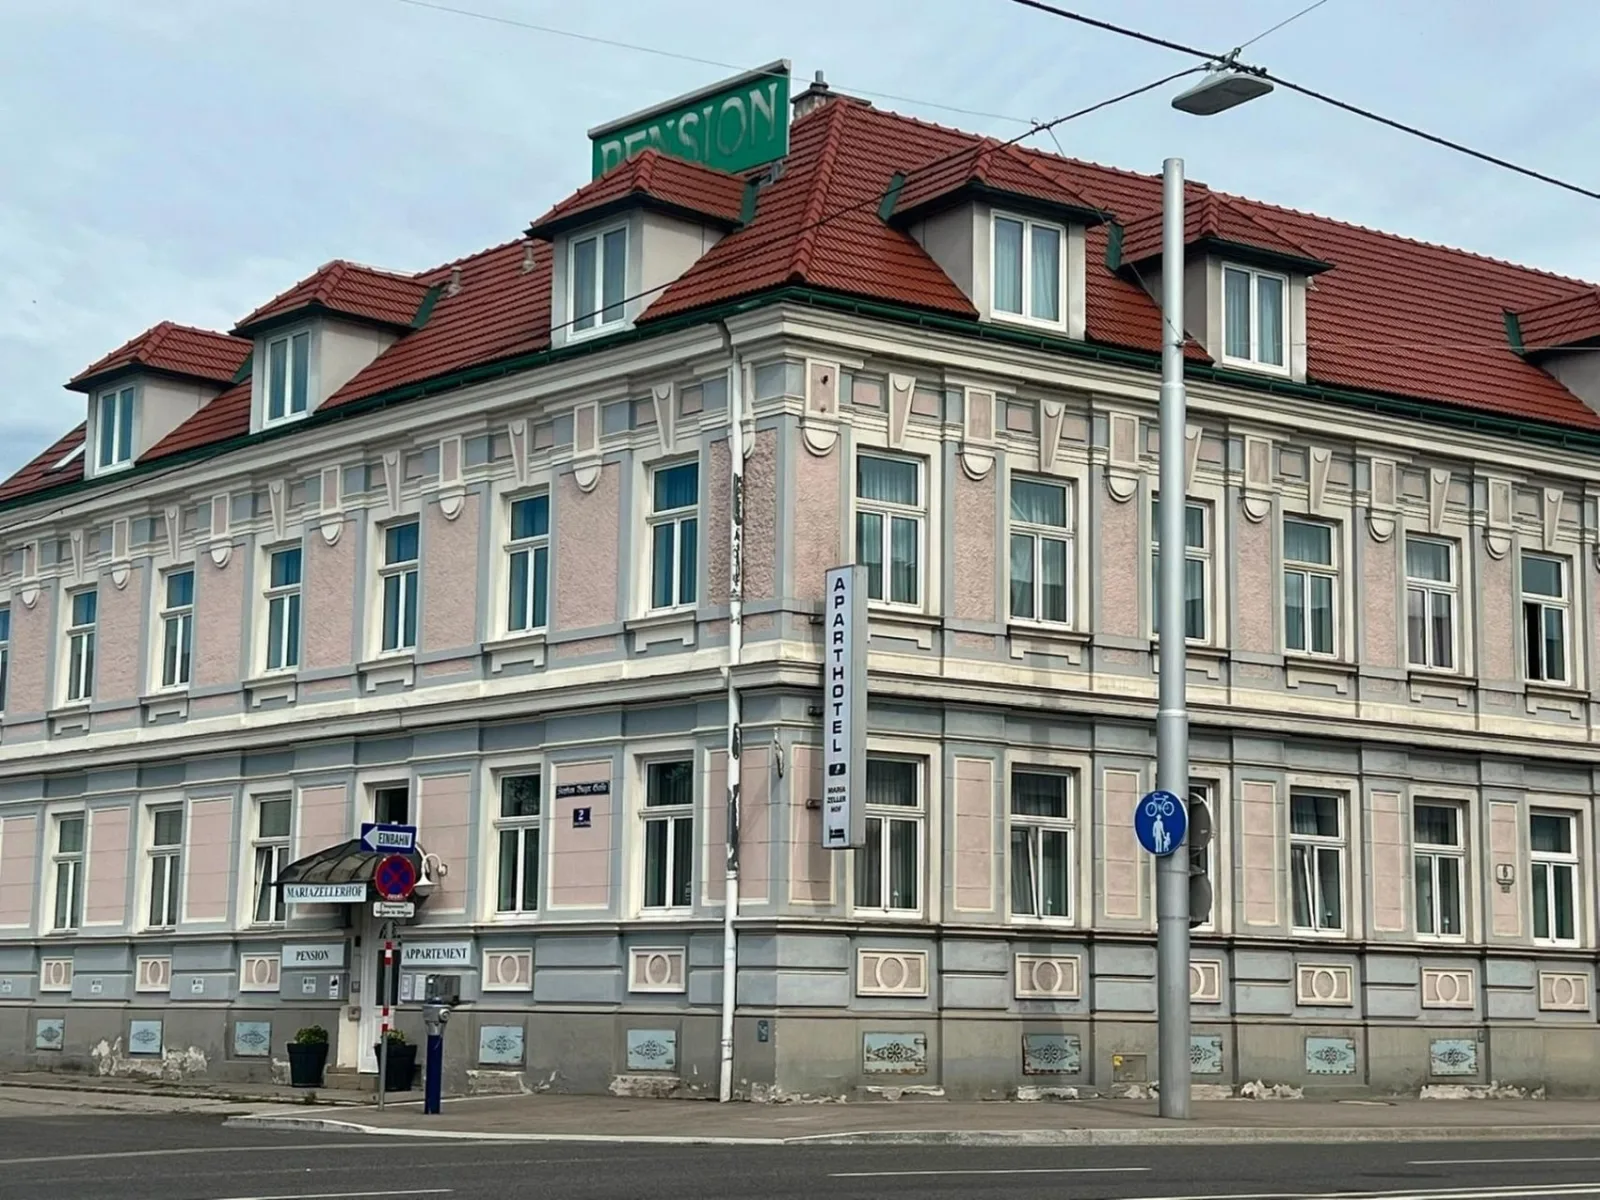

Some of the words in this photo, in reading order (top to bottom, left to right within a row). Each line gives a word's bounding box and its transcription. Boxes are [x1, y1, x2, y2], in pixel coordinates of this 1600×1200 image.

[832, 577, 845, 752] APARTHOTEL
[578, 809, 584, 821] 2
[378, 833, 410, 845] EINBAHN
[287, 886, 363, 898] MARIAZELLERHOF
[295, 950, 329, 961] PENSION
[404, 948, 467, 960] APPARTEMENT
